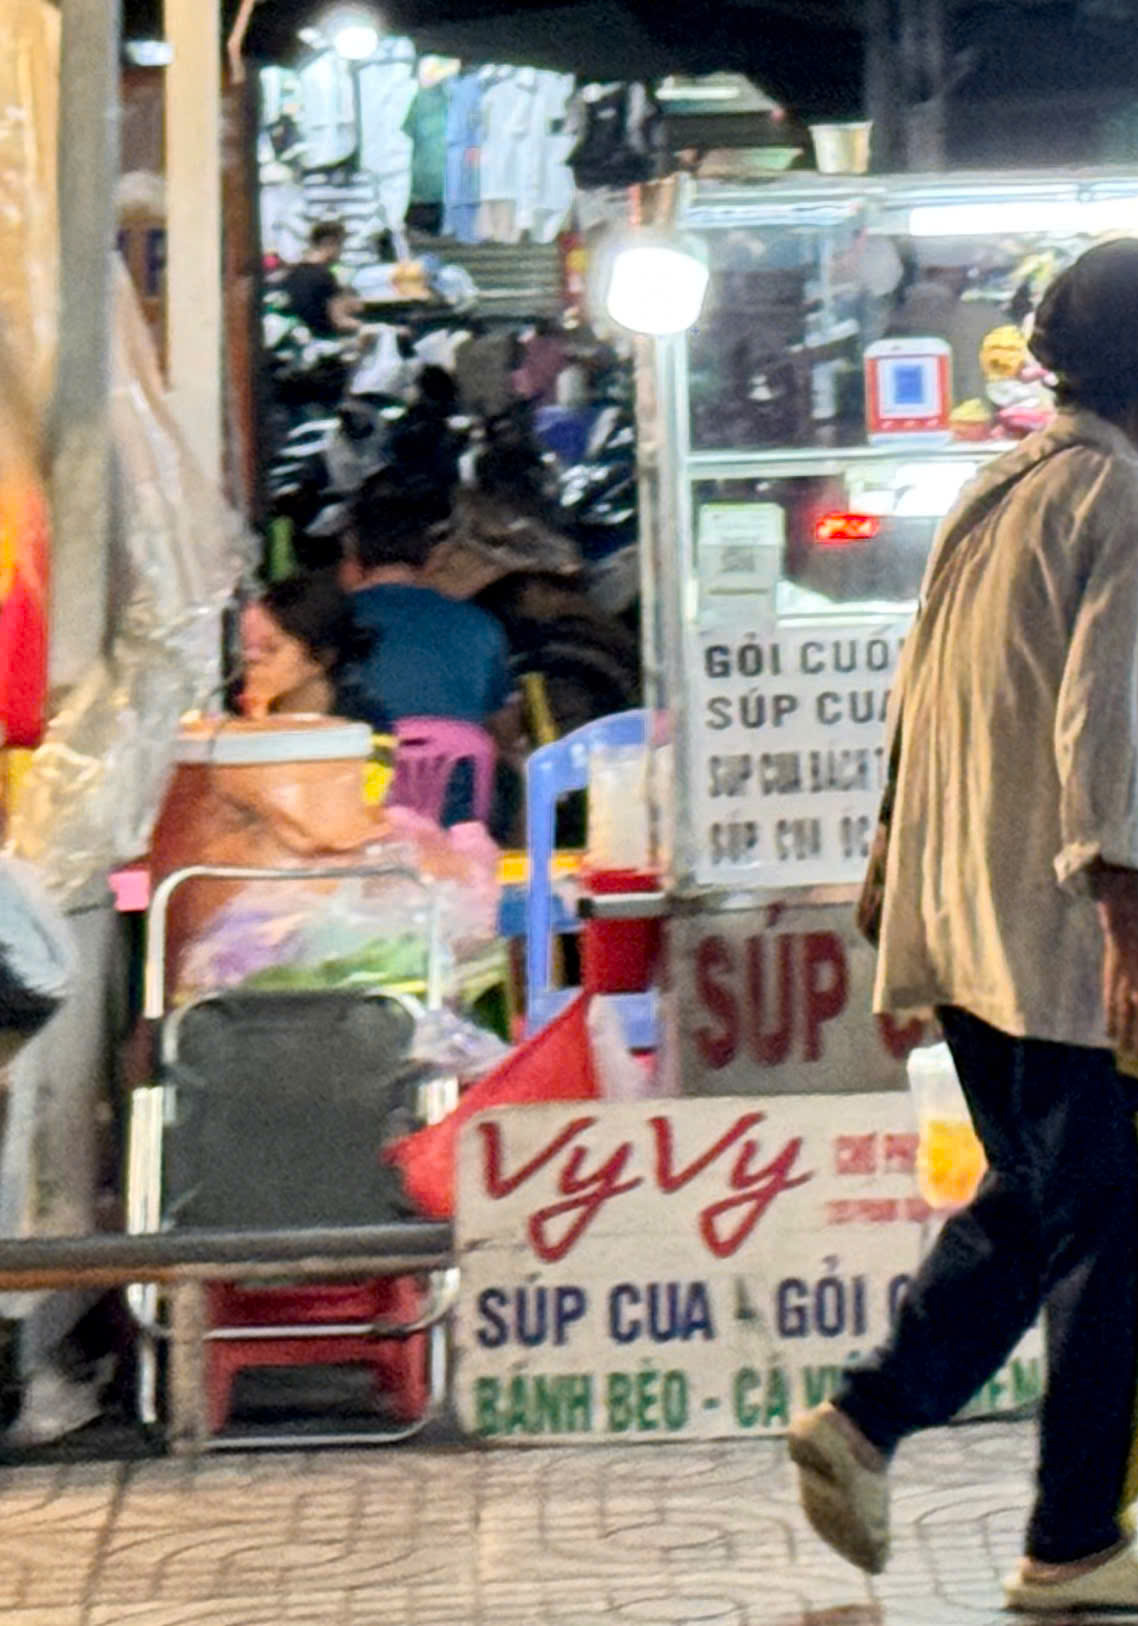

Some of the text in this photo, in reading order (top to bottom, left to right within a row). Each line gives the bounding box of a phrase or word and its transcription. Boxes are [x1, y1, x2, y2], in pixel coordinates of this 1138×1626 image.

[704, 632, 783, 679] GỎI
[705, 687, 799, 731] SÚP
[695, 899, 849, 1070] SÚP
[475, 1273, 587, 1350] SÚP
[608, 1279, 717, 1345] CUA
[775, 1254, 868, 1338] GỎI
